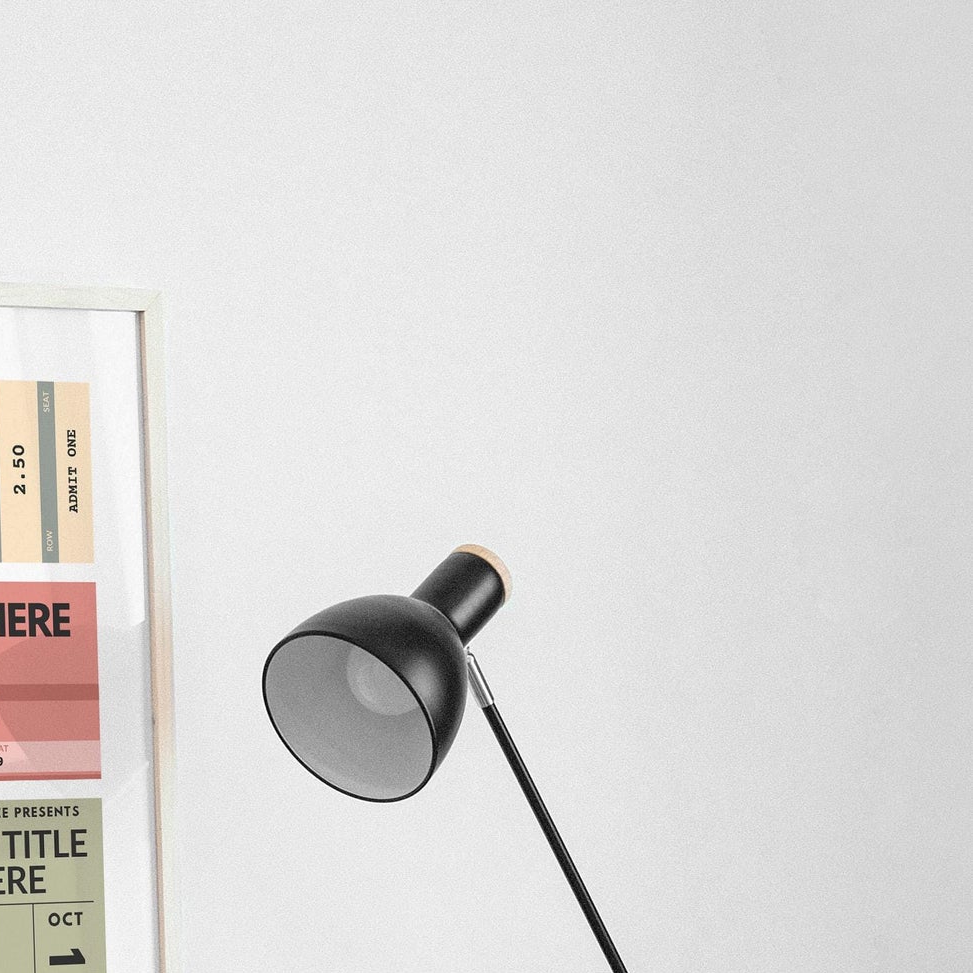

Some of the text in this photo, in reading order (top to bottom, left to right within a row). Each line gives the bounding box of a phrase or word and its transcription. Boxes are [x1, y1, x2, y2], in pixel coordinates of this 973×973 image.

[11, 444, 26, 495] 2.50
[14, 805, 80, 818] PRESENTS
[1, 828, 88, 860] TITLE
[48, 911, 84, 927] OCT
